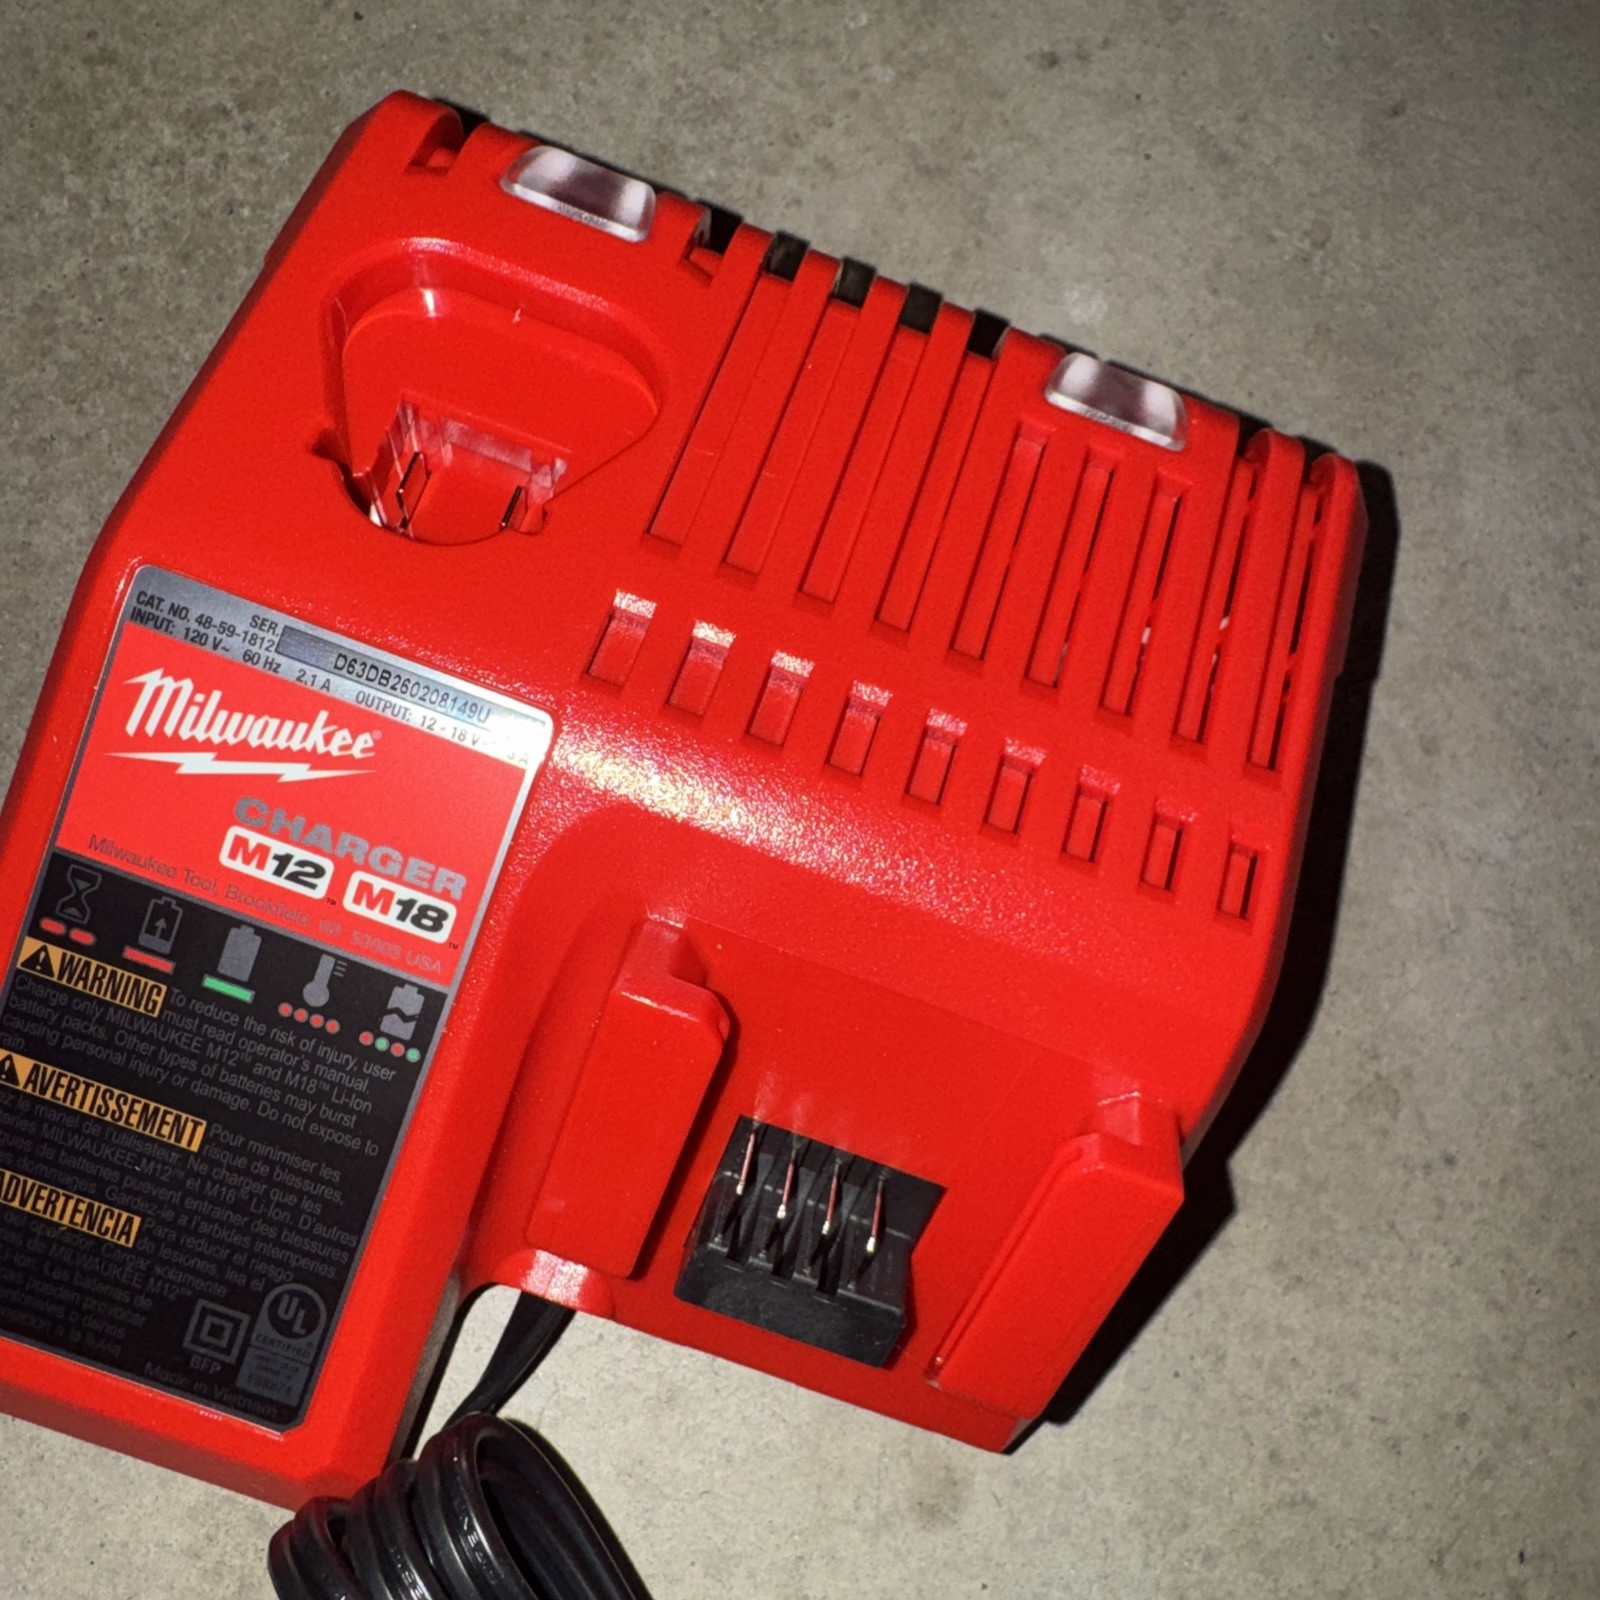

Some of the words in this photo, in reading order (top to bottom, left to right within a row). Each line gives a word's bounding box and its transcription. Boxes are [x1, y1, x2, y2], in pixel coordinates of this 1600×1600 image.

[135, 589, 167, 612] CAT.
[167, 601, 193, 622] NO.
[192, 612, 277, 653] 48-59-1812
[248, 614, 282, 637] SER.
[129, 606, 177, 634] INPUT:
[182, 625, 210, 646] 120
[241, 648, 261, 666] 60
[262, 655, 282, 674] Hz
[295, 668, 318, 687] 2.1
[319, 677, 333, 692] A
[353, 690, 413, 722] OUTPUT:
[418, 714, 437, 731] 12
[123, 668, 376, 759] Milwaukee
[226, 833, 328, 891] M12
[350, 879, 450, 936] M18
[230, 794, 469, 900] CHARGER
[87, 833, 179, 879] Milwaukee
[403, 949, 445, 976] USA
[53, 951, 163, 1014] WARNING
[6, 992, 61, 1025] battery
[60, 1011, 111, 1043] packs.
[112, 1029, 157, 1057] Other
[156, 1046, 200, 1076] types
[199, 1061, 218, 1079] of
[217, 1066, 284, 1103] batteries
[282, 1092, 317, 1117] may
[318, 1102, 357, 1128] burst
[12, 973, 70, 1009] Charge
[69, 994, 105, 1021] only
[104, 1006, 204, 1053] MILWAUKEE
[251, 1059, 282, 1082] and
[161, 1006, 200, 1031] must
[200, 1020, 236, 1045] read
[235, 1034, 312, 1076] operator's
[312, 1061, 372, 1094] manual.
[168, 988, 188, 1008] To
[187, 995, 241, 1027] reduce
[242, 1016, 268, 1037] the
[269, 1024, 298, 1047] risk
[298, 1035, 316, 1053] of
[315, 1041, 361, 1072] injury,
[361, 1060, 397, 1083] user
[0, 1011, 61, 1046] causing
[60, 1032, 127, 1069] personal
[126, 1055, 170, 1085] injury
[170, 1072, 188, 1089] or
[187, 1078, 255, 1115] damage.
[255, 1100, 280, 1121] Do
[280, 1110, 307, 1131] not
[306, 1122, 361, 1153] expose
[363, 1139, 381, 1157] to
[22, 1062, 203, 1149] AVERTISSEMENT
[39, 1122, 139, 1169] MILWAUKEE
[184, 1174, 202, 1191] et
[297, 1213, 360, 1248] D'autres
[80, 1116, 103, 1137] de
[185, 1154, 209, 1174] Ne
[209, 1163, 268, 1198] charger
[267, 1186, 298, 1210] que
[298, 1194, 324, 1215] les
[200, 1141, 249, 1173] risque
[249, 1158, 271, 1177] de
[271, 1165, 347, 1205] blessures,
[208, 1123, 246, 1148] Pour
[246, 1137, 318, 1174] minimiser
[318, 1162, 343, 1183] les
[135, 1234, 157, 1254] de
[157, 1242, 223, 1278] lesiones,
[224, 1265, 249, 1286] lea
[249, 1274, 266, 1292] el
[141, 1216, 179, 1242] Para
[179, 1231, 231, 1260] reducir
[231, 1249, 247, 1266] el
[247, 1255, 295, 1287] riesgo
[152, 1260, 229, 1298] solamente
[249, 1216, 279, 1239] des
[279, 1227, 351, 1264] blessures
